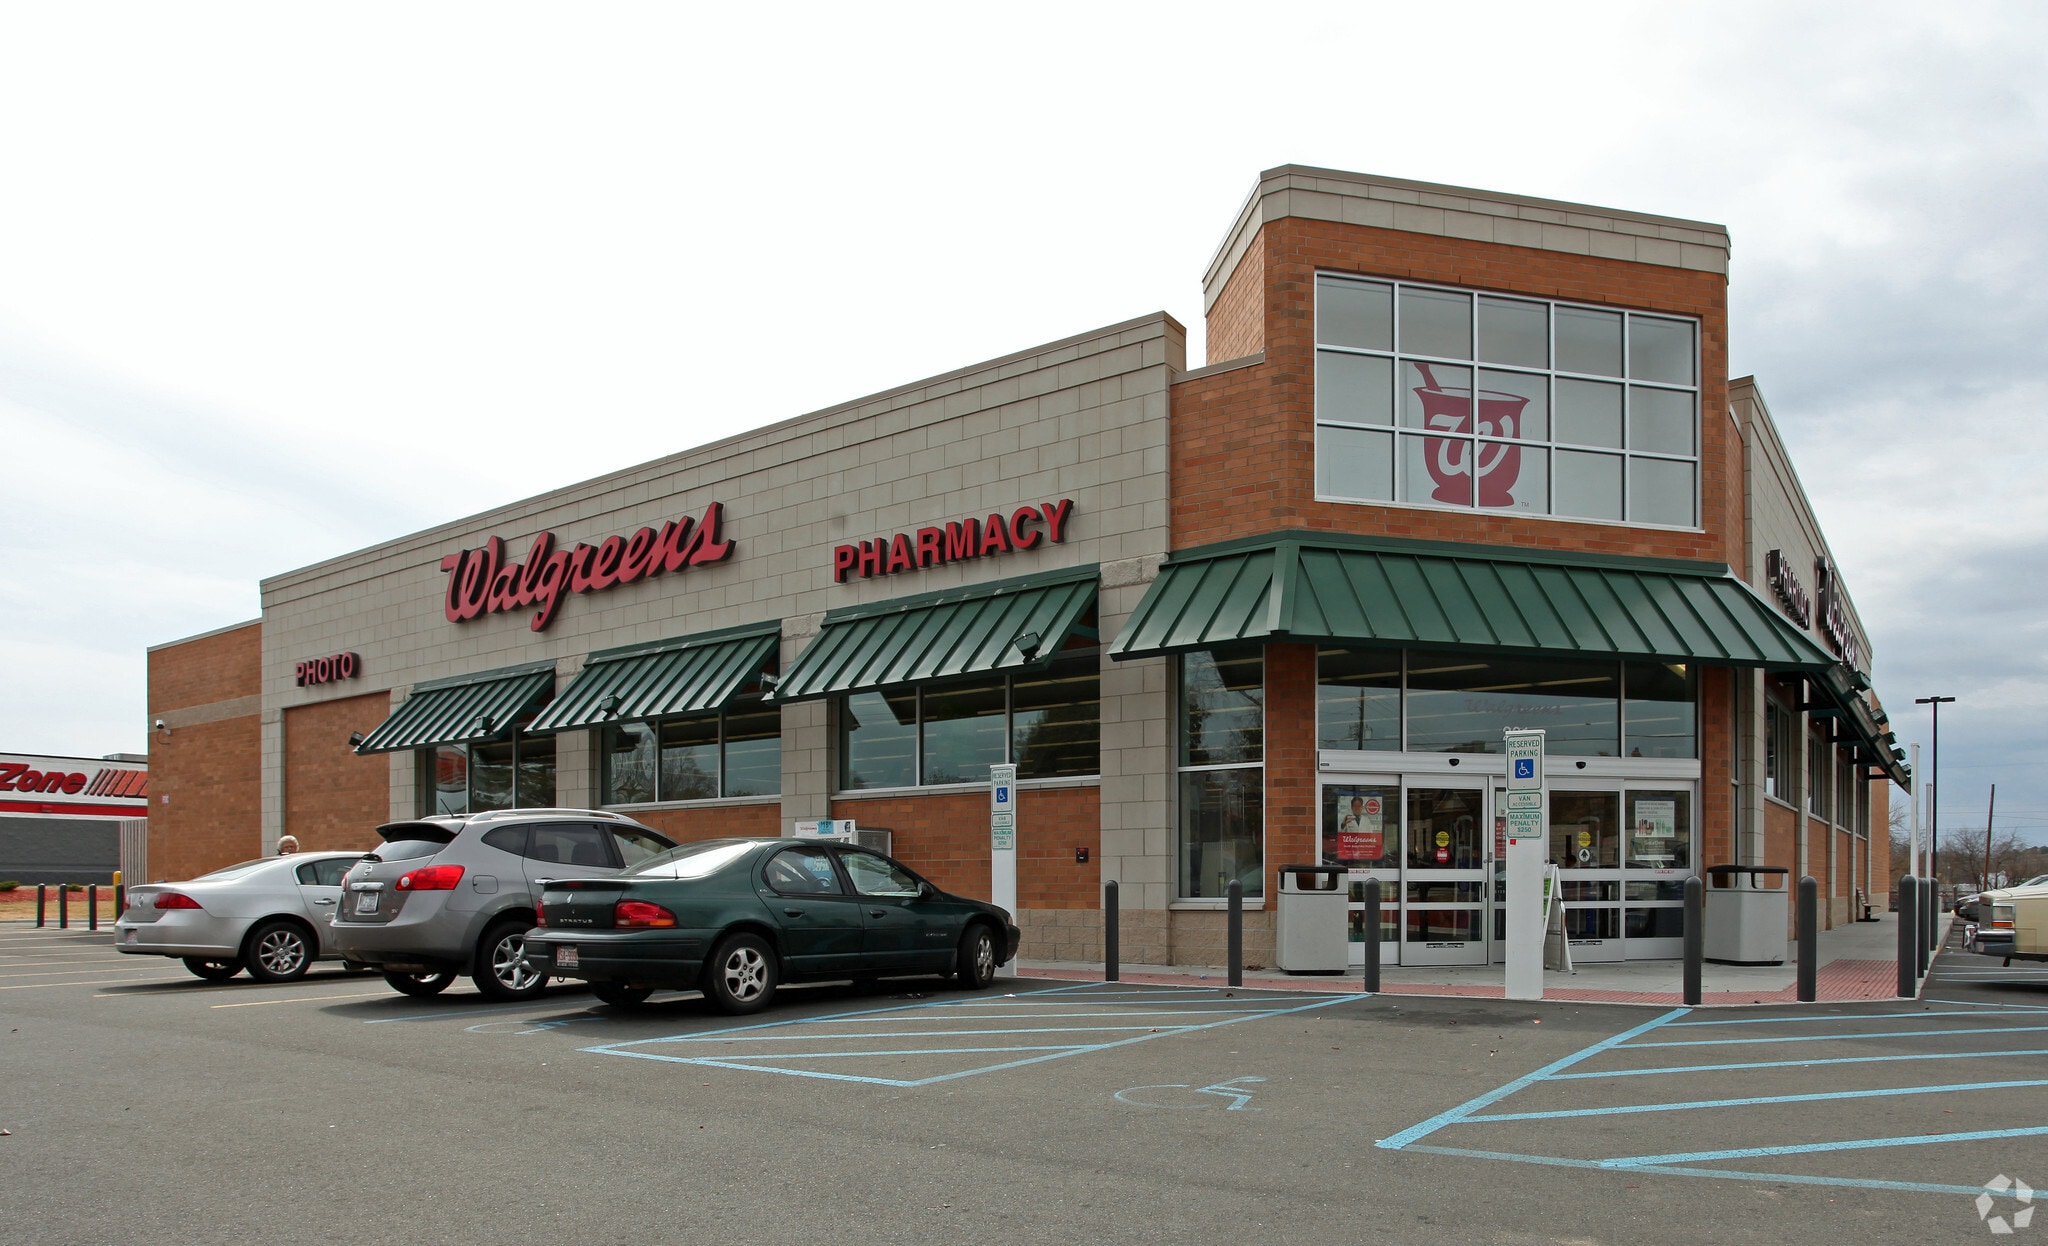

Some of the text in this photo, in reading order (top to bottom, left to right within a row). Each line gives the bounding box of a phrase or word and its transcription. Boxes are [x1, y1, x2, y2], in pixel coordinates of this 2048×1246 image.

[834, 498, 1074, 583] PHARMACY
[440, 501, 737, 632] Walgreens
[296, 651, 361, 688] PHOTO
[1508, 739, 1540, 748] RESERVED
[1510, 749, 1538, 757] PARKING
[1342, 835, 1377, 845] Walgreens
